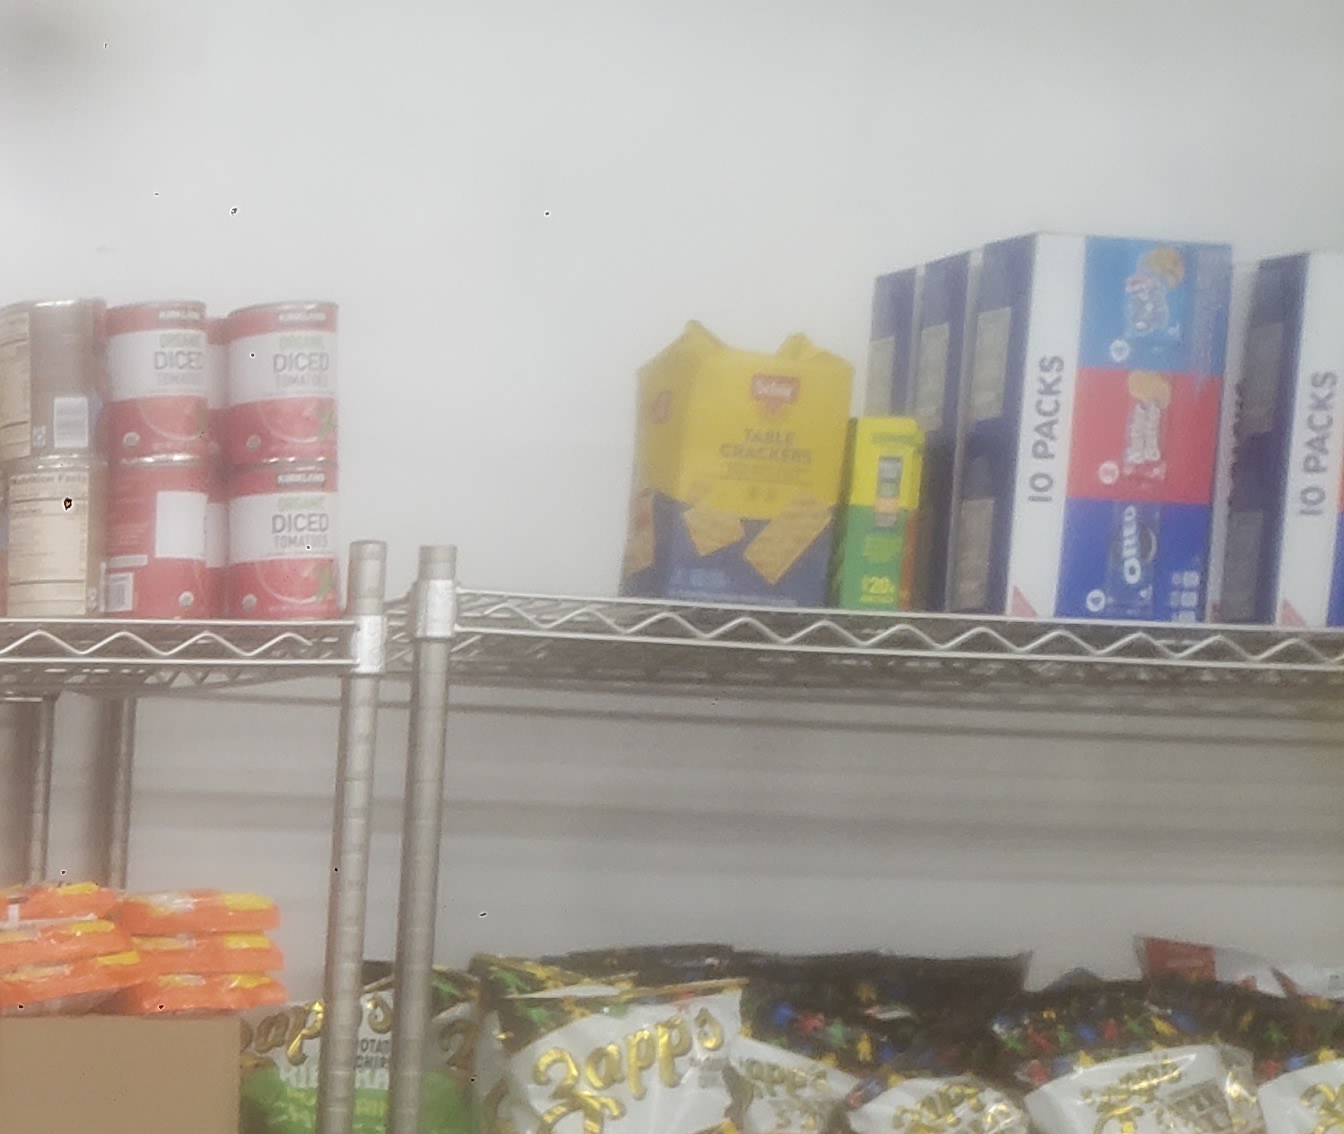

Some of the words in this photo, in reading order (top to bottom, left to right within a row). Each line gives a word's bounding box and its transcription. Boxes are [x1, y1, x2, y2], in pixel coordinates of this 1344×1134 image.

[273, 352, 330, 373] DICED
[1032, 354, 1064, 459] PACKS
[744, 427, 796, 443] TABLE
[1303, 369, 1340, 475] PACKS
[719, 443, 812, 463] CRACKERS
[1028, 472, 1054, 504] 10
[1298, 484, 1327, 517] 10
[270, 513, 330, 535] DICED
